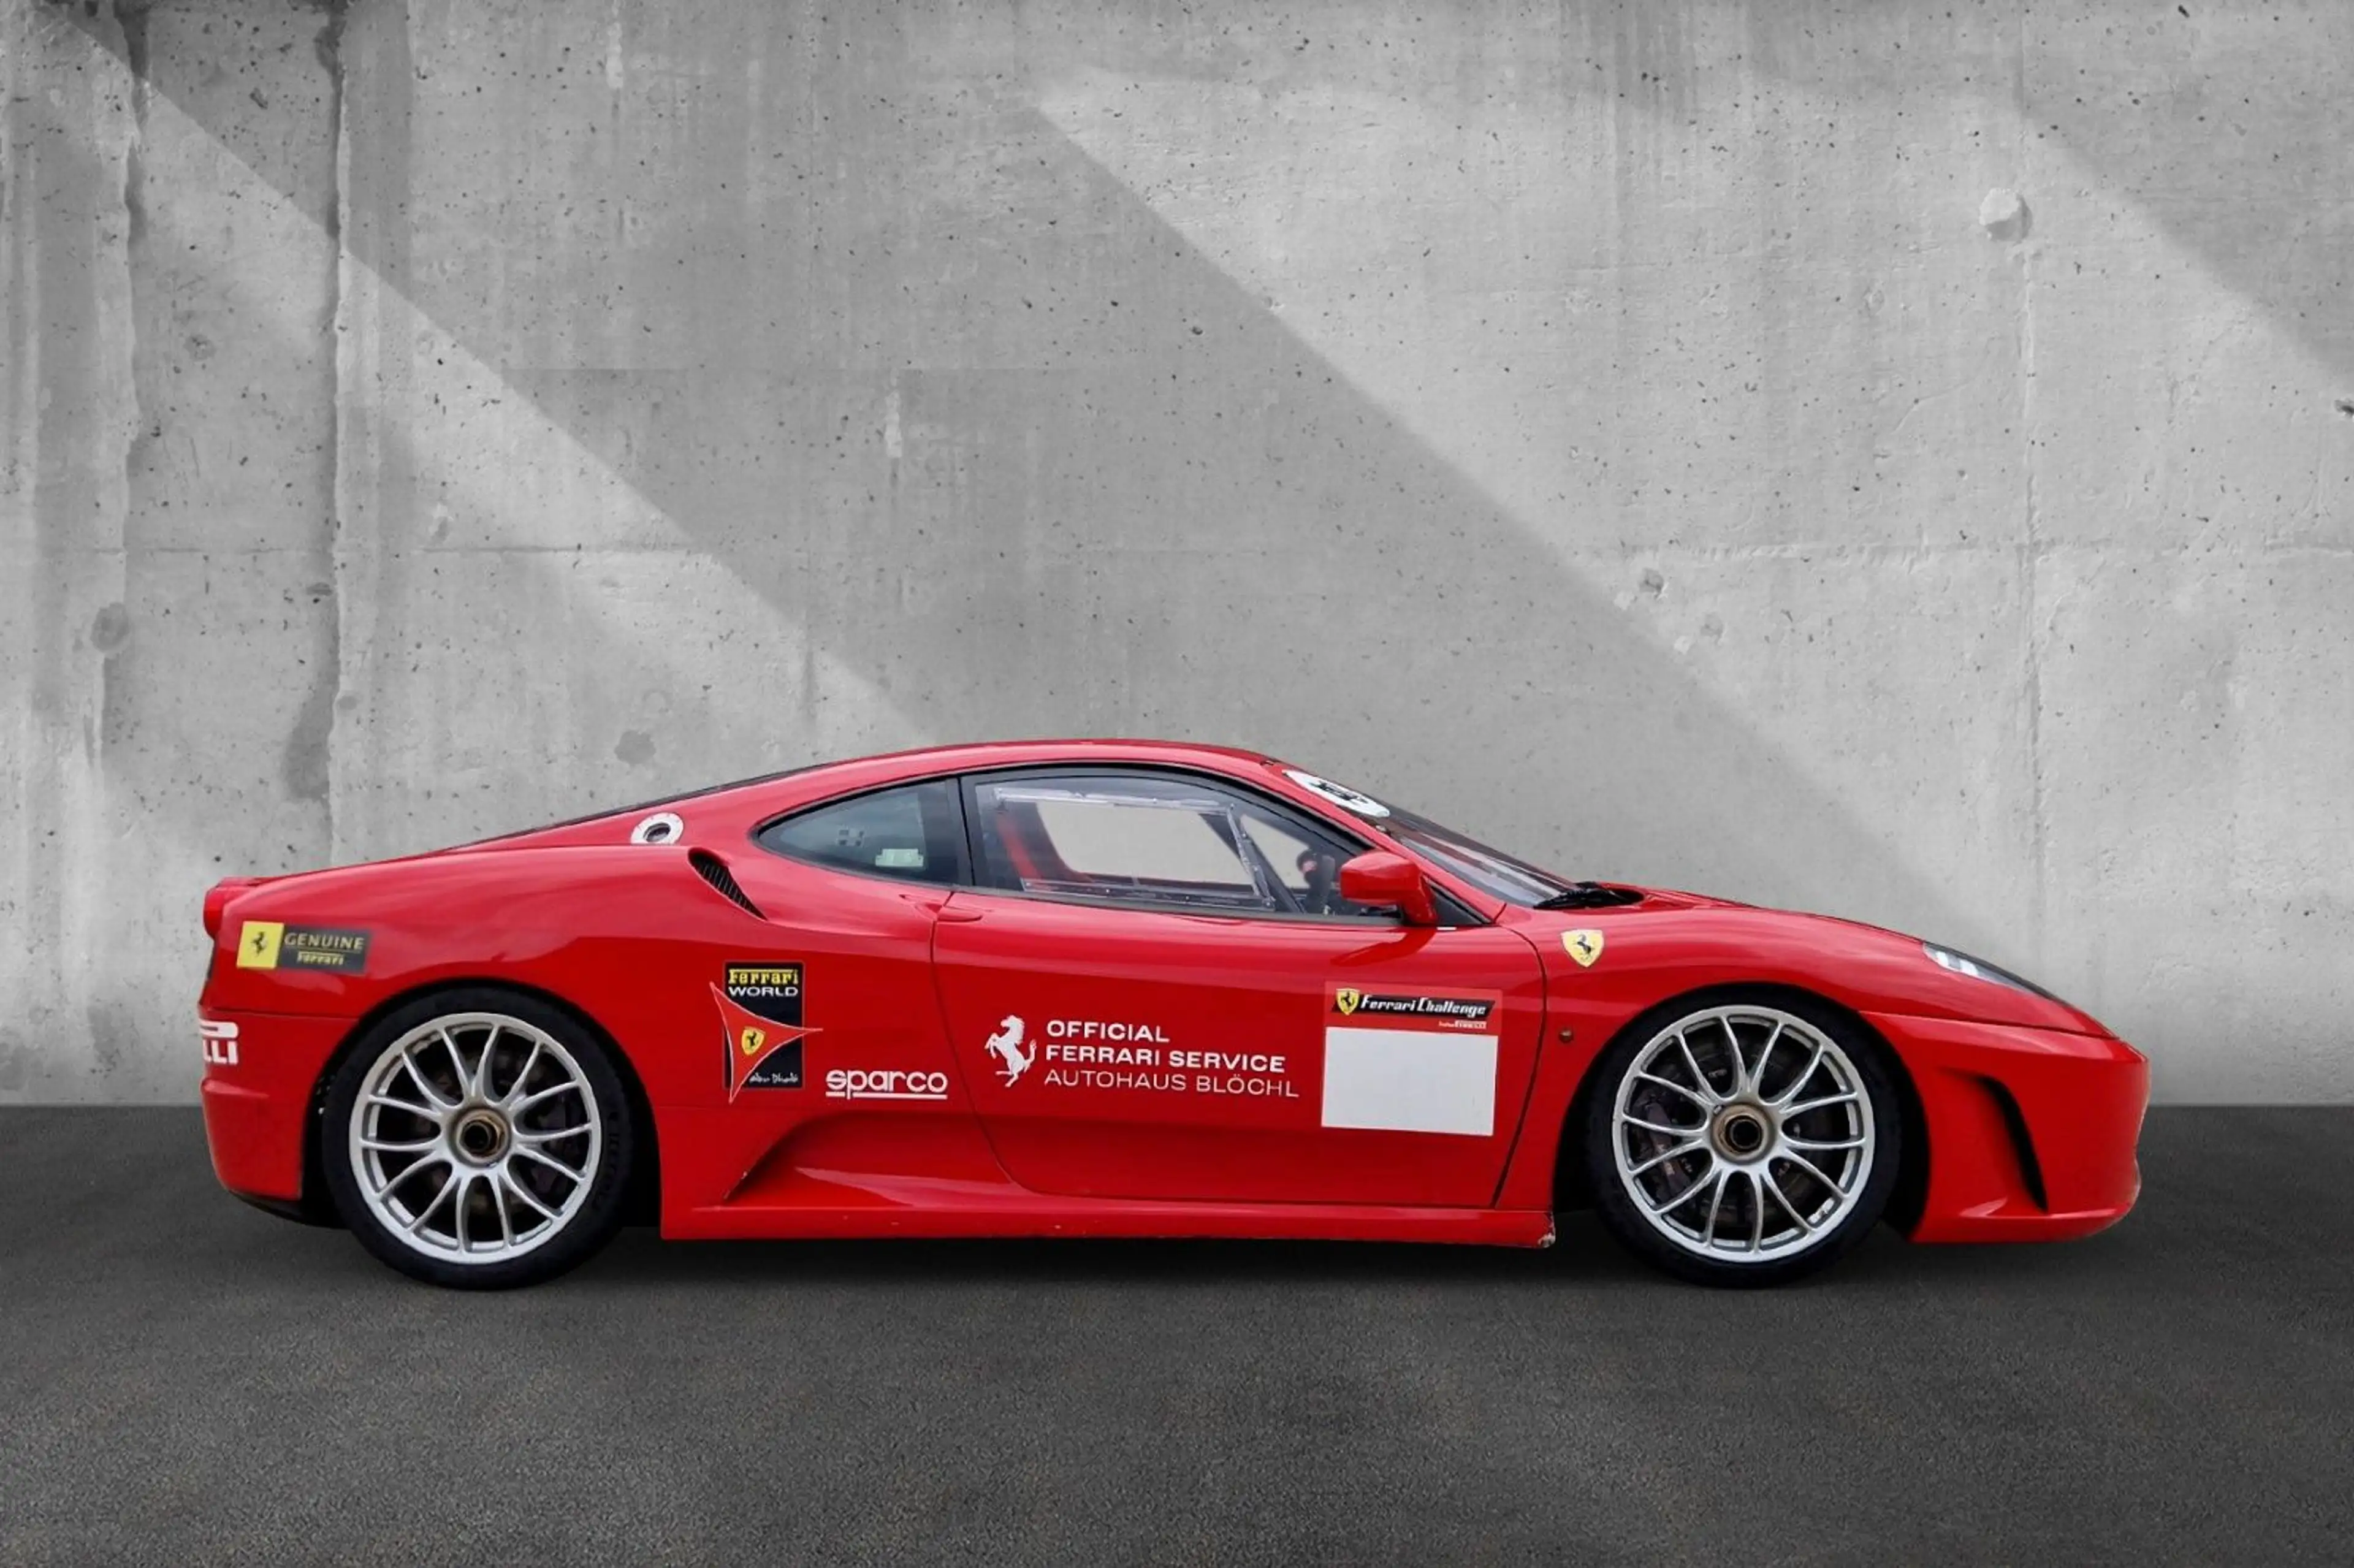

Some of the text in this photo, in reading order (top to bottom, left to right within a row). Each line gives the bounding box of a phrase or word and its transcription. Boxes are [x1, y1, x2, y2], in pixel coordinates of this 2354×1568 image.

[284, 932, 364, 950] GENUINE
[297, 951, 345, 965] Ferrari
[728, 969, 798, 984] Ferrari
[728, 986, 798, 997] WORLD
[1360, 994, 1487, 1018] Ferrari Challenge
[1047, 1020, 1170, 1042] OFFICIAL
[1046, 1045, 1286, 1072] FERRARI SERVICE
[826, 1070, 948, 1100] sparco
[1044, 1069, 1299, 1097] AUTOHAUS BLÖCHL
